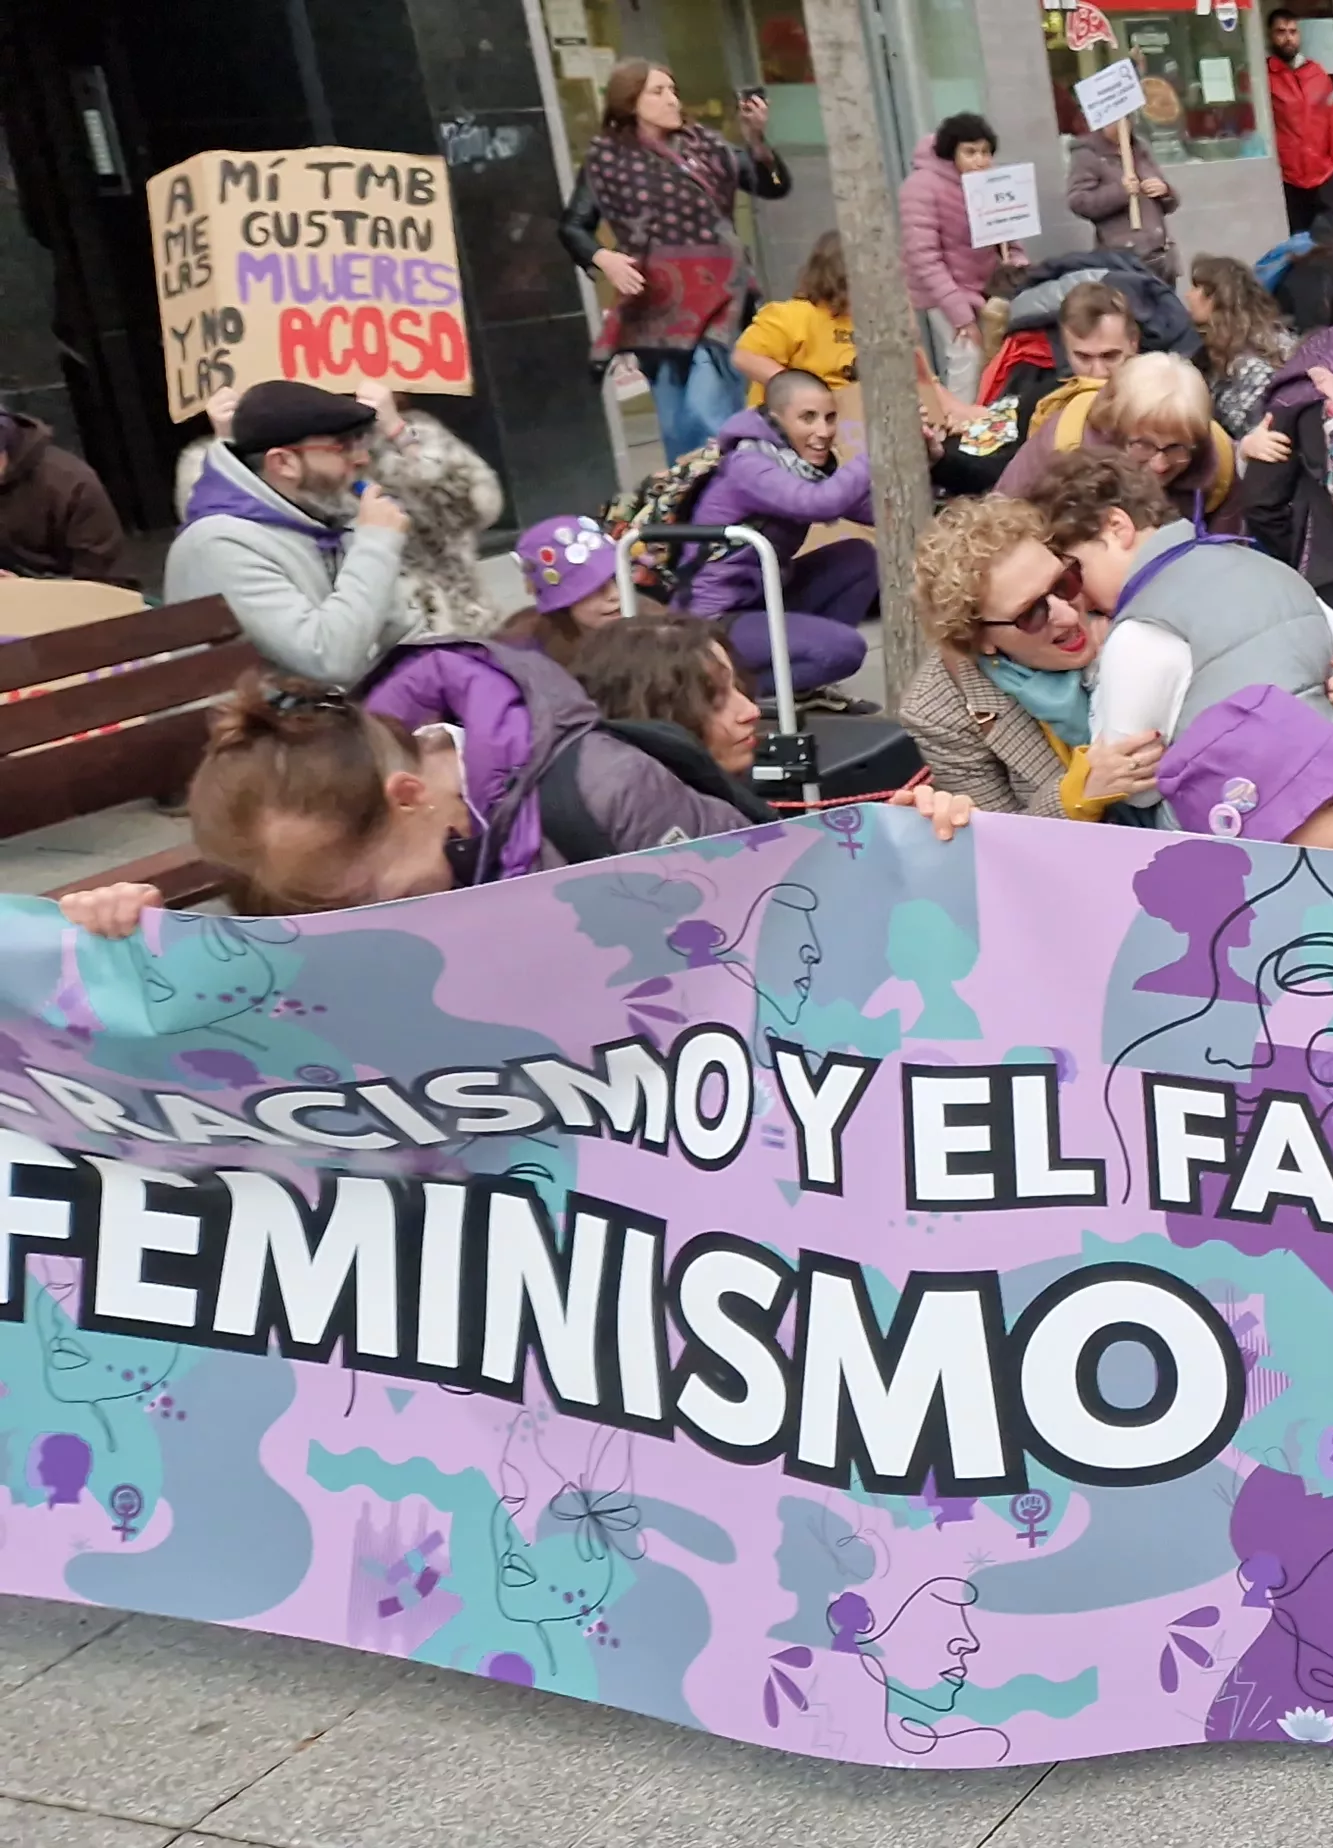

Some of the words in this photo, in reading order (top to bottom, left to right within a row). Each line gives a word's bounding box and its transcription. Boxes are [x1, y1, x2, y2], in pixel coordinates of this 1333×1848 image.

[167, 175, 195, 223] A
[304, 161, 436, 206] TMB
[163, 216, 209, 264] ME
[242, 210, 432, 251] GUSTAN
[163, 255, 212, 298] LAS
[236, 251, 459, 306] MUJERES
[171, 319, 193, 361] Y
[201, 306, 244, 353] NO
[177, 349, 236, 409] LAS
[279, 305, 467, 381] ACOSO
[22, 1024, 754, 1170] RACISMO
[768, 1037, 882, 1196] Y
[902, 1062, 1107, 1211] EL
[0, 1128, 1247, 1497] FEMINISMO
